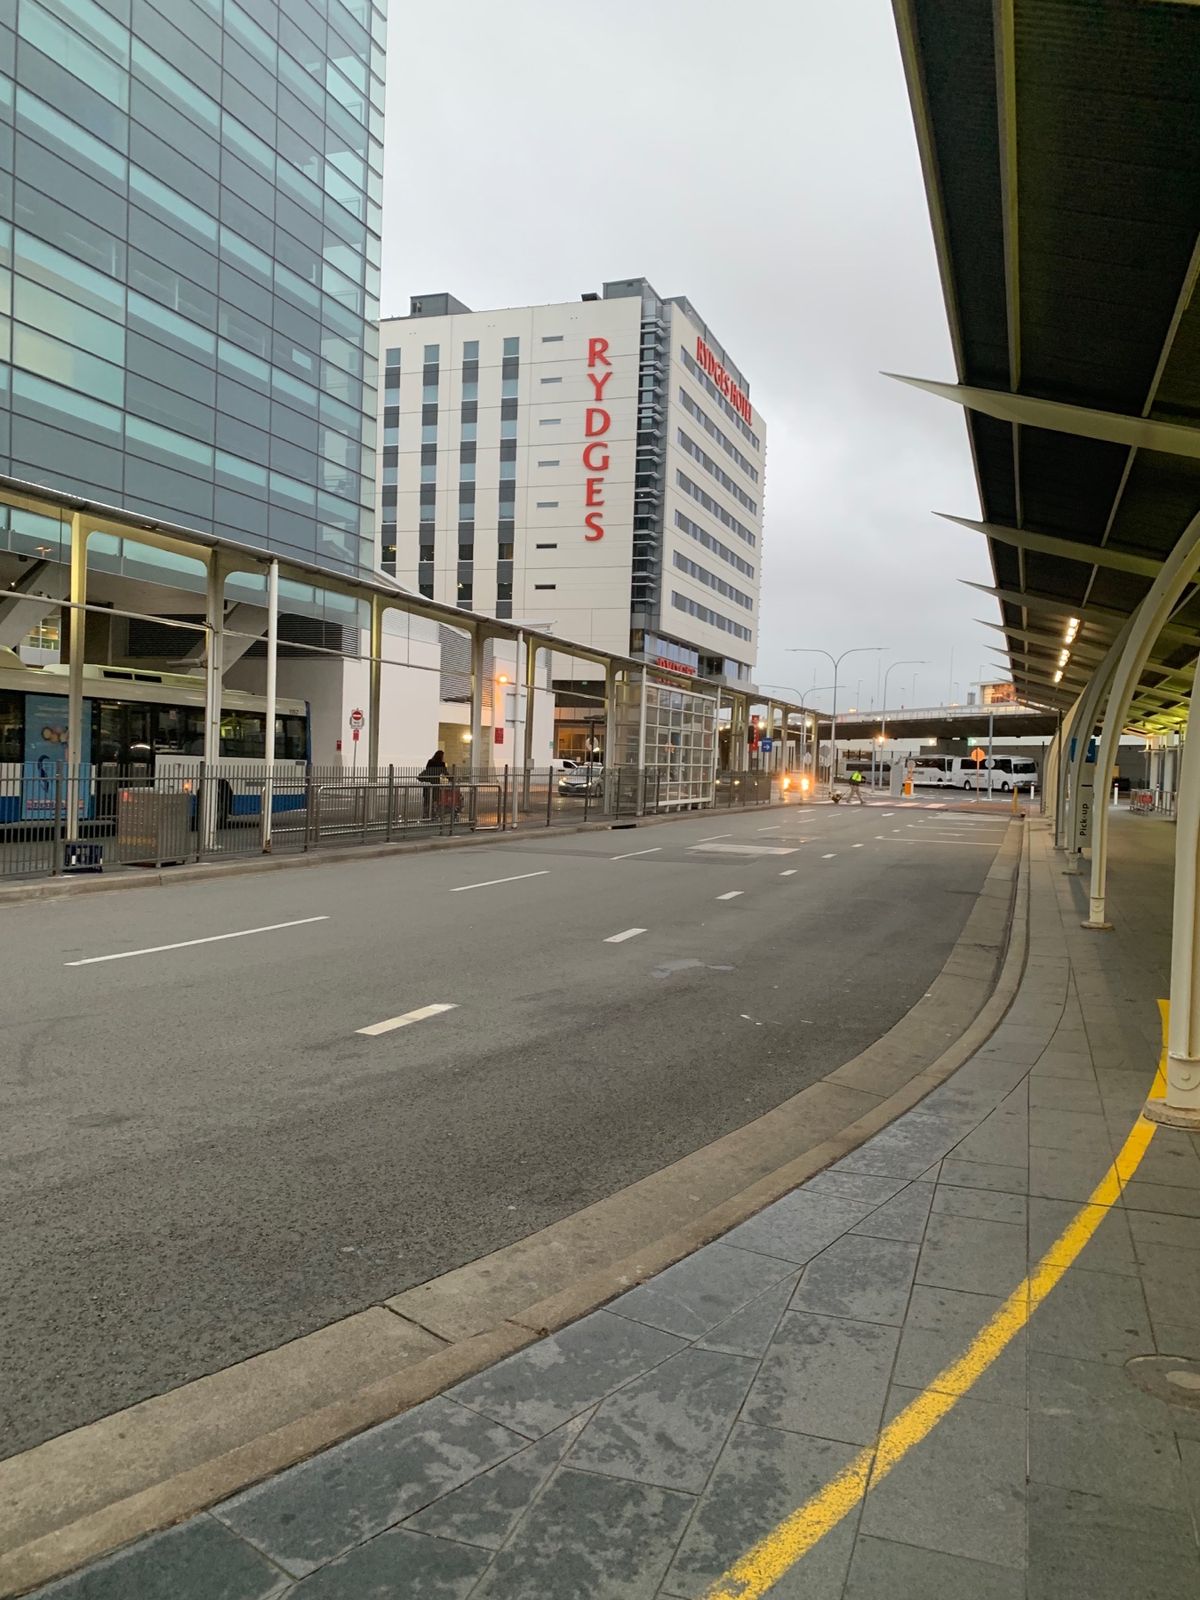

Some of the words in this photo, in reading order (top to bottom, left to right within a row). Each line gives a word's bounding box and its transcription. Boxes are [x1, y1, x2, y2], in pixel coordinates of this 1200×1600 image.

[697, 336, 730, 396] RYDGES
[730, 380, 752, 427] HOTEL
[582, 337, 613, 541] RYDGES
[1080, 803, 1089, 836] Pick-up
